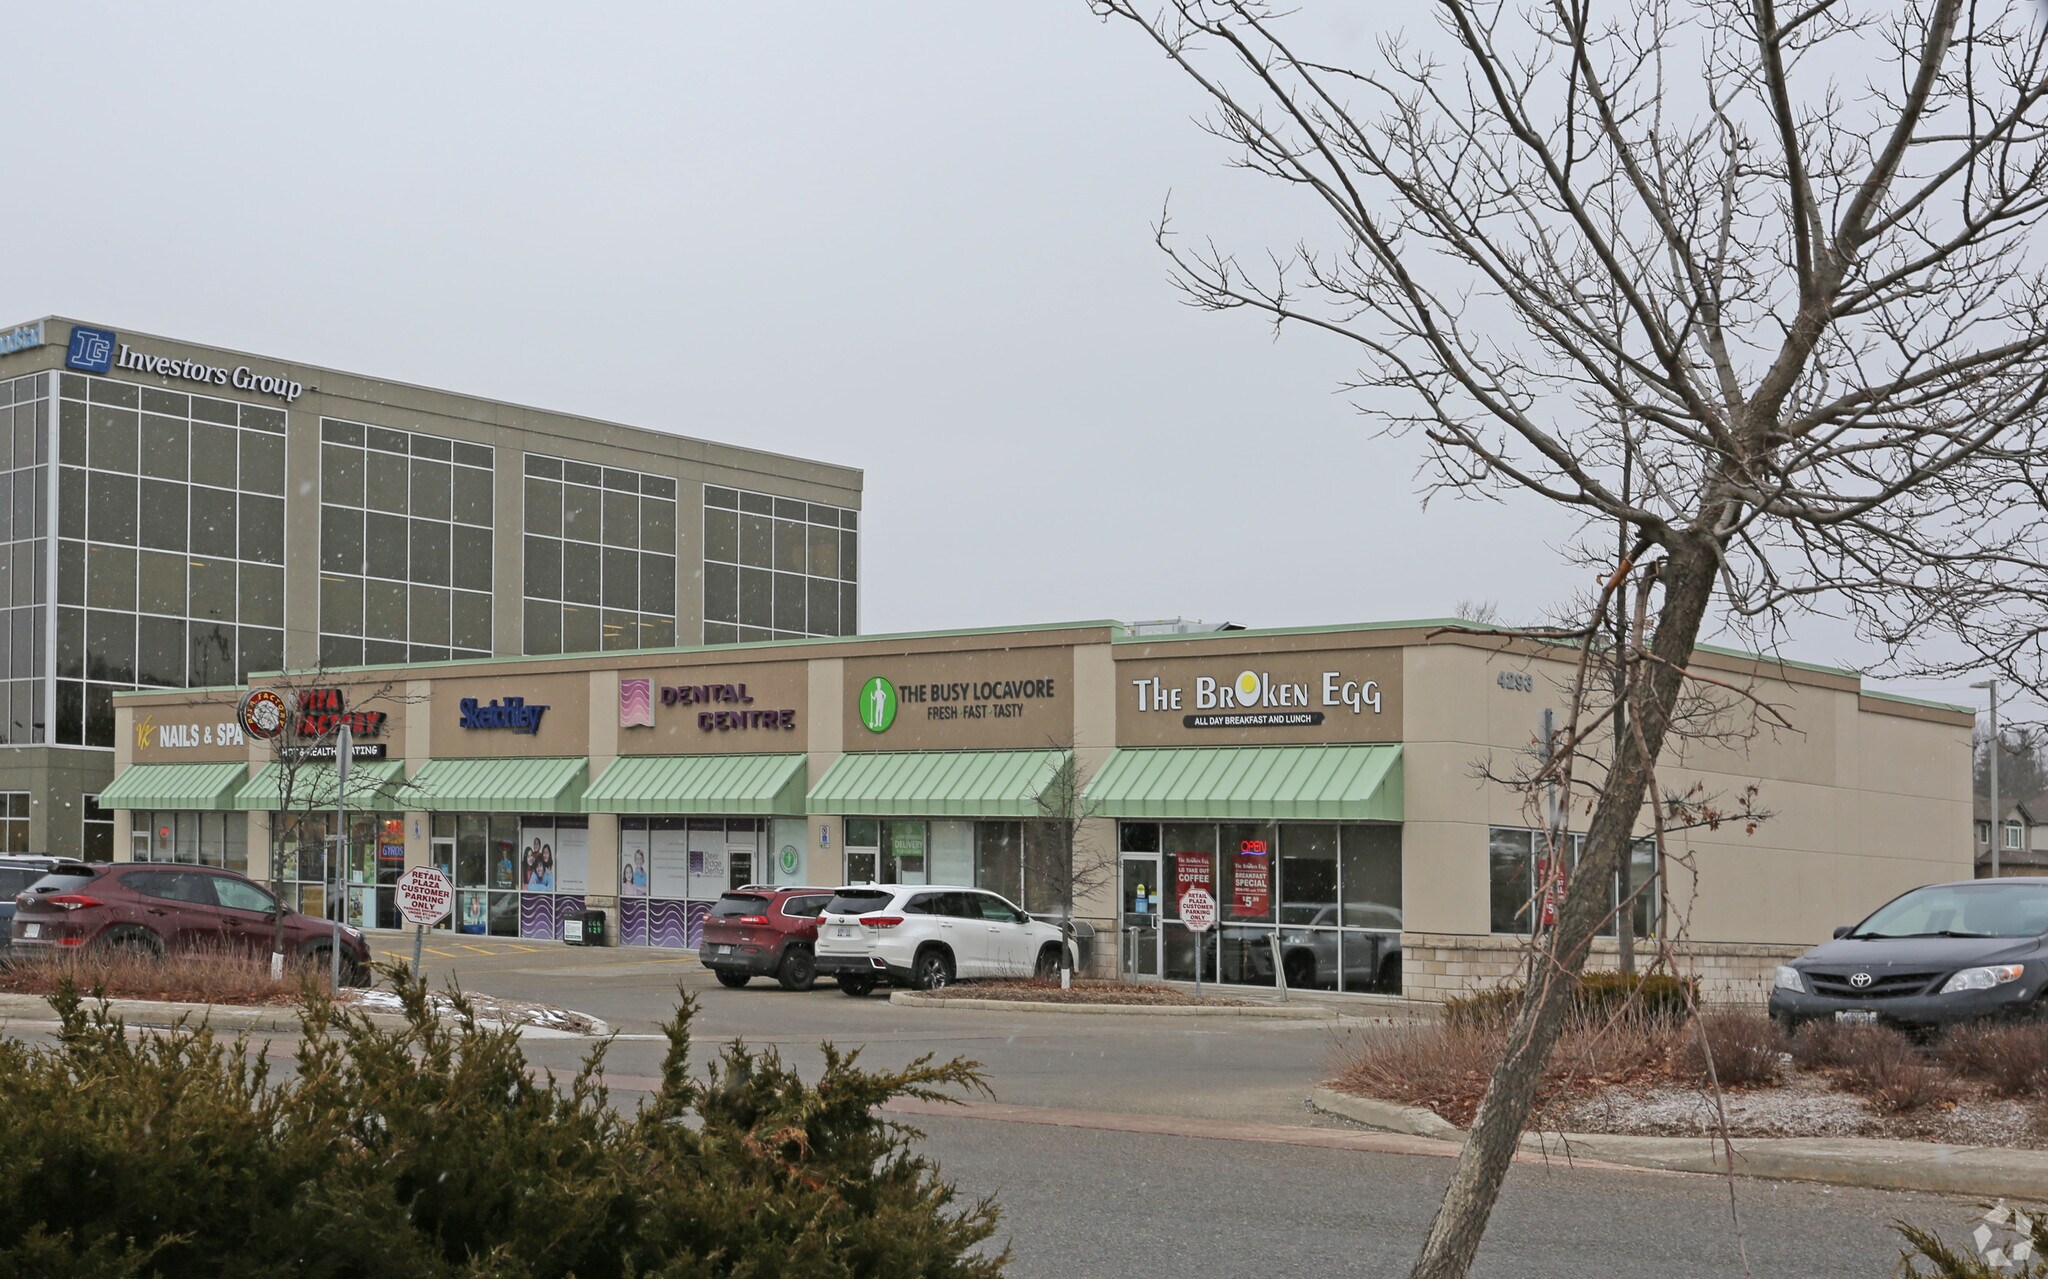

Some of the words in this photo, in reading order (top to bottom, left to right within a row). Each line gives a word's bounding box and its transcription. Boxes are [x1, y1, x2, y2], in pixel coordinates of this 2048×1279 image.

[117, 343, 229, 386] Investors
[232, 365, 303, 401] Group
[1497, 672, 1533, 692] 4293
[660, 683, 754, 705] DENTAL
[899, 685, 927, 703] THE
[931, 683, 970, 702] BUSY
[973, 679, 1055, 701] LOCAVORE
[459, 696, 547, 736] Sketchley
[928, 705, 957, 720] FRESH
[963, 704, 988, 719] FAST
[993, 703, 1024, 718] TASTY
[698, 709, 796, 731] CENTRE
[1194, 717, 1208, 726] ALL
[1209, 716, 1224, 725] DAY
[1225, 715, 1268, 725] BREAKFAST
[1268, 715, 1284, 724] AND
[1286, 714, 1312, 723] LUNCH
[160, 723, 199, 748] NAILS
[204, 725, 213, 744] &
[217, 722, 244, 747] SPA
[351, 746, 378, 756] ATING
[895, 840, 923, 849] DELIVERY
[1240, 840, 1267, 852] OPEN
[383, 845, 404, 857] GYROS
[412, 871, 443, 882] RETAIL
[705, 867, 724, 875] Dental
[1235, 872, 1267, 880] BREAKFAST
[412, 878, 440, 889] PLAZA
[1178, 873, 1210, 883] COFFEE
[1235, 879, 1267, 888] SPECIAL
[401, 884, 450, 899] CUSTOMER
[405, 892, 444, 905] PARKING
[412, 901, 435, 911] ONLY
